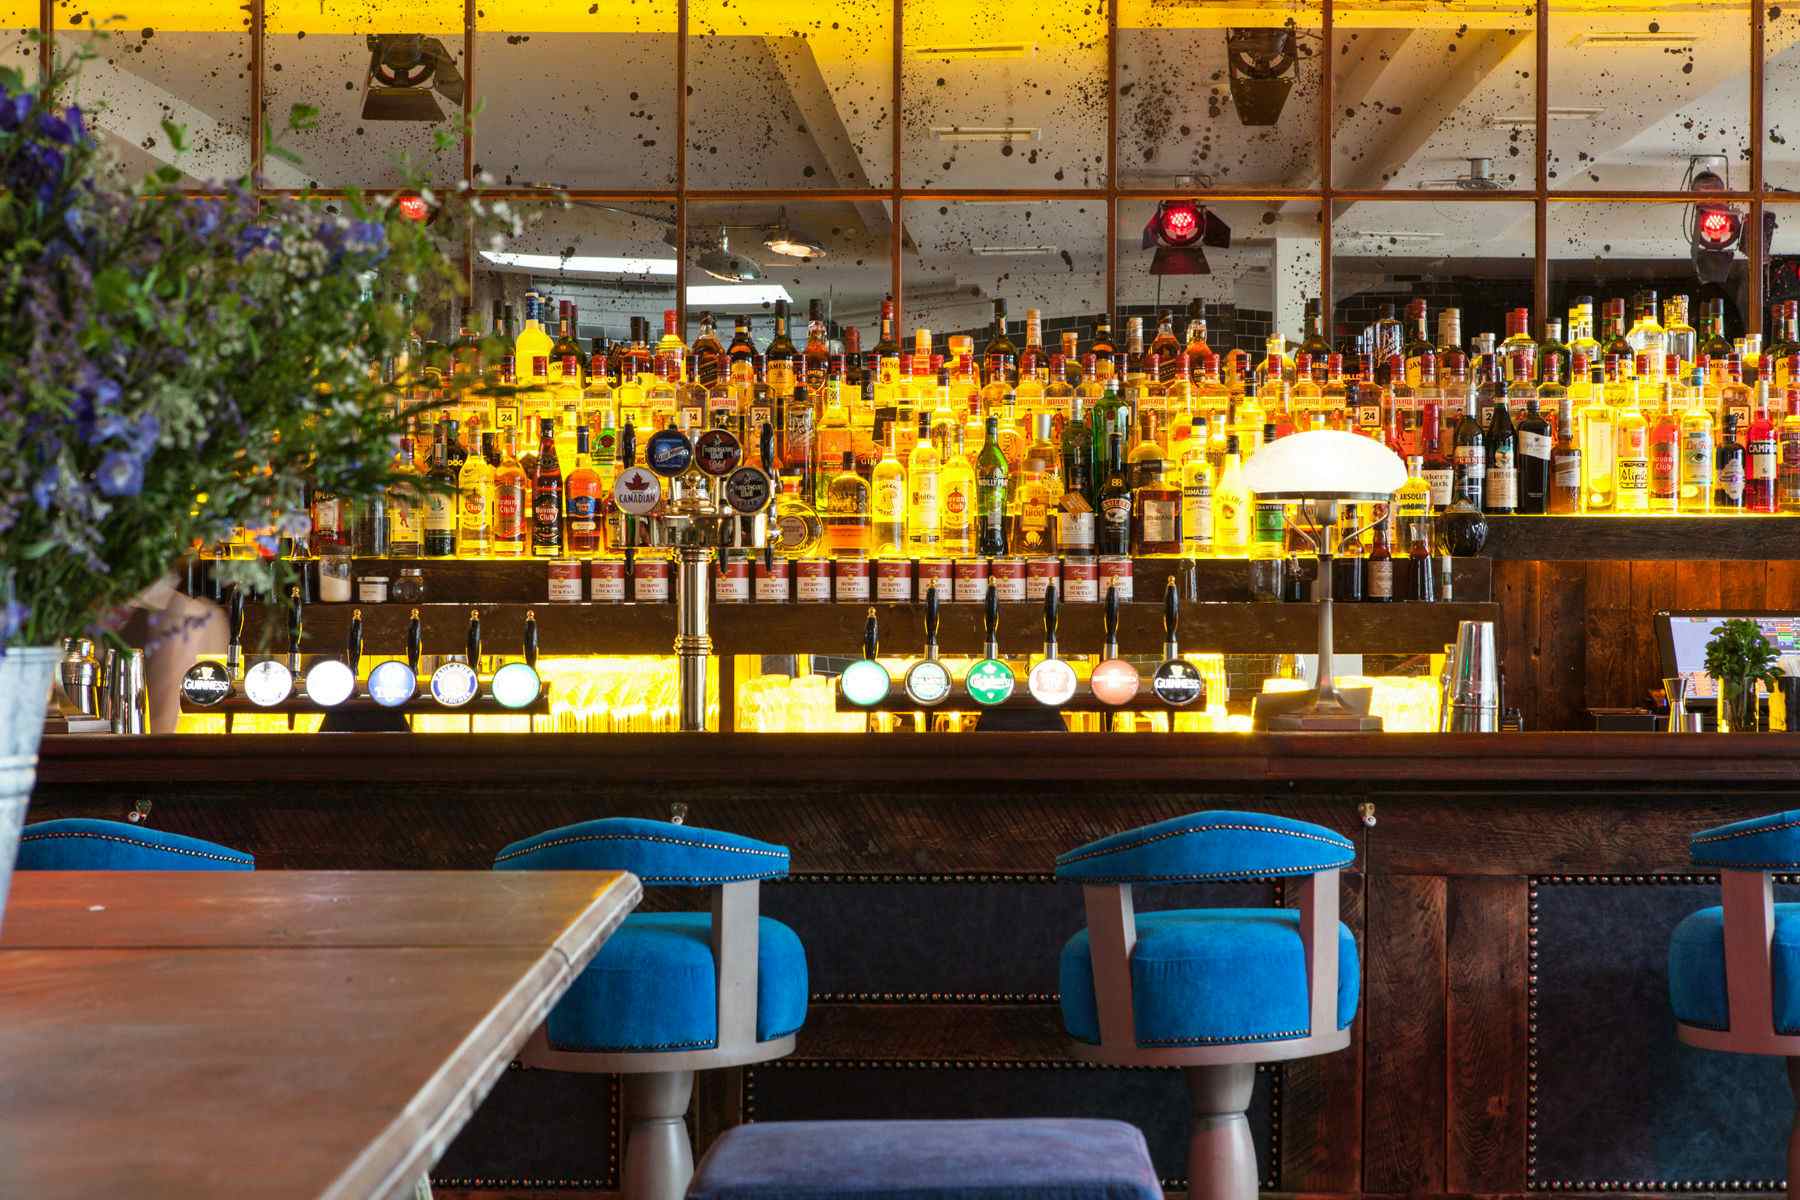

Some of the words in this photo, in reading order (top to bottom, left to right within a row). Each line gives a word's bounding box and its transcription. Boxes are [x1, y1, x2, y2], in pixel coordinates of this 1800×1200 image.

[501, 414, 512, 422] 24
[1364, 412, 1376, 420] 24
[618, 493, 656, 504] CANADIAN
[184, 679, 229, 691] GUINNESS
[1155, 678, 1200, 690] GUINNESS
